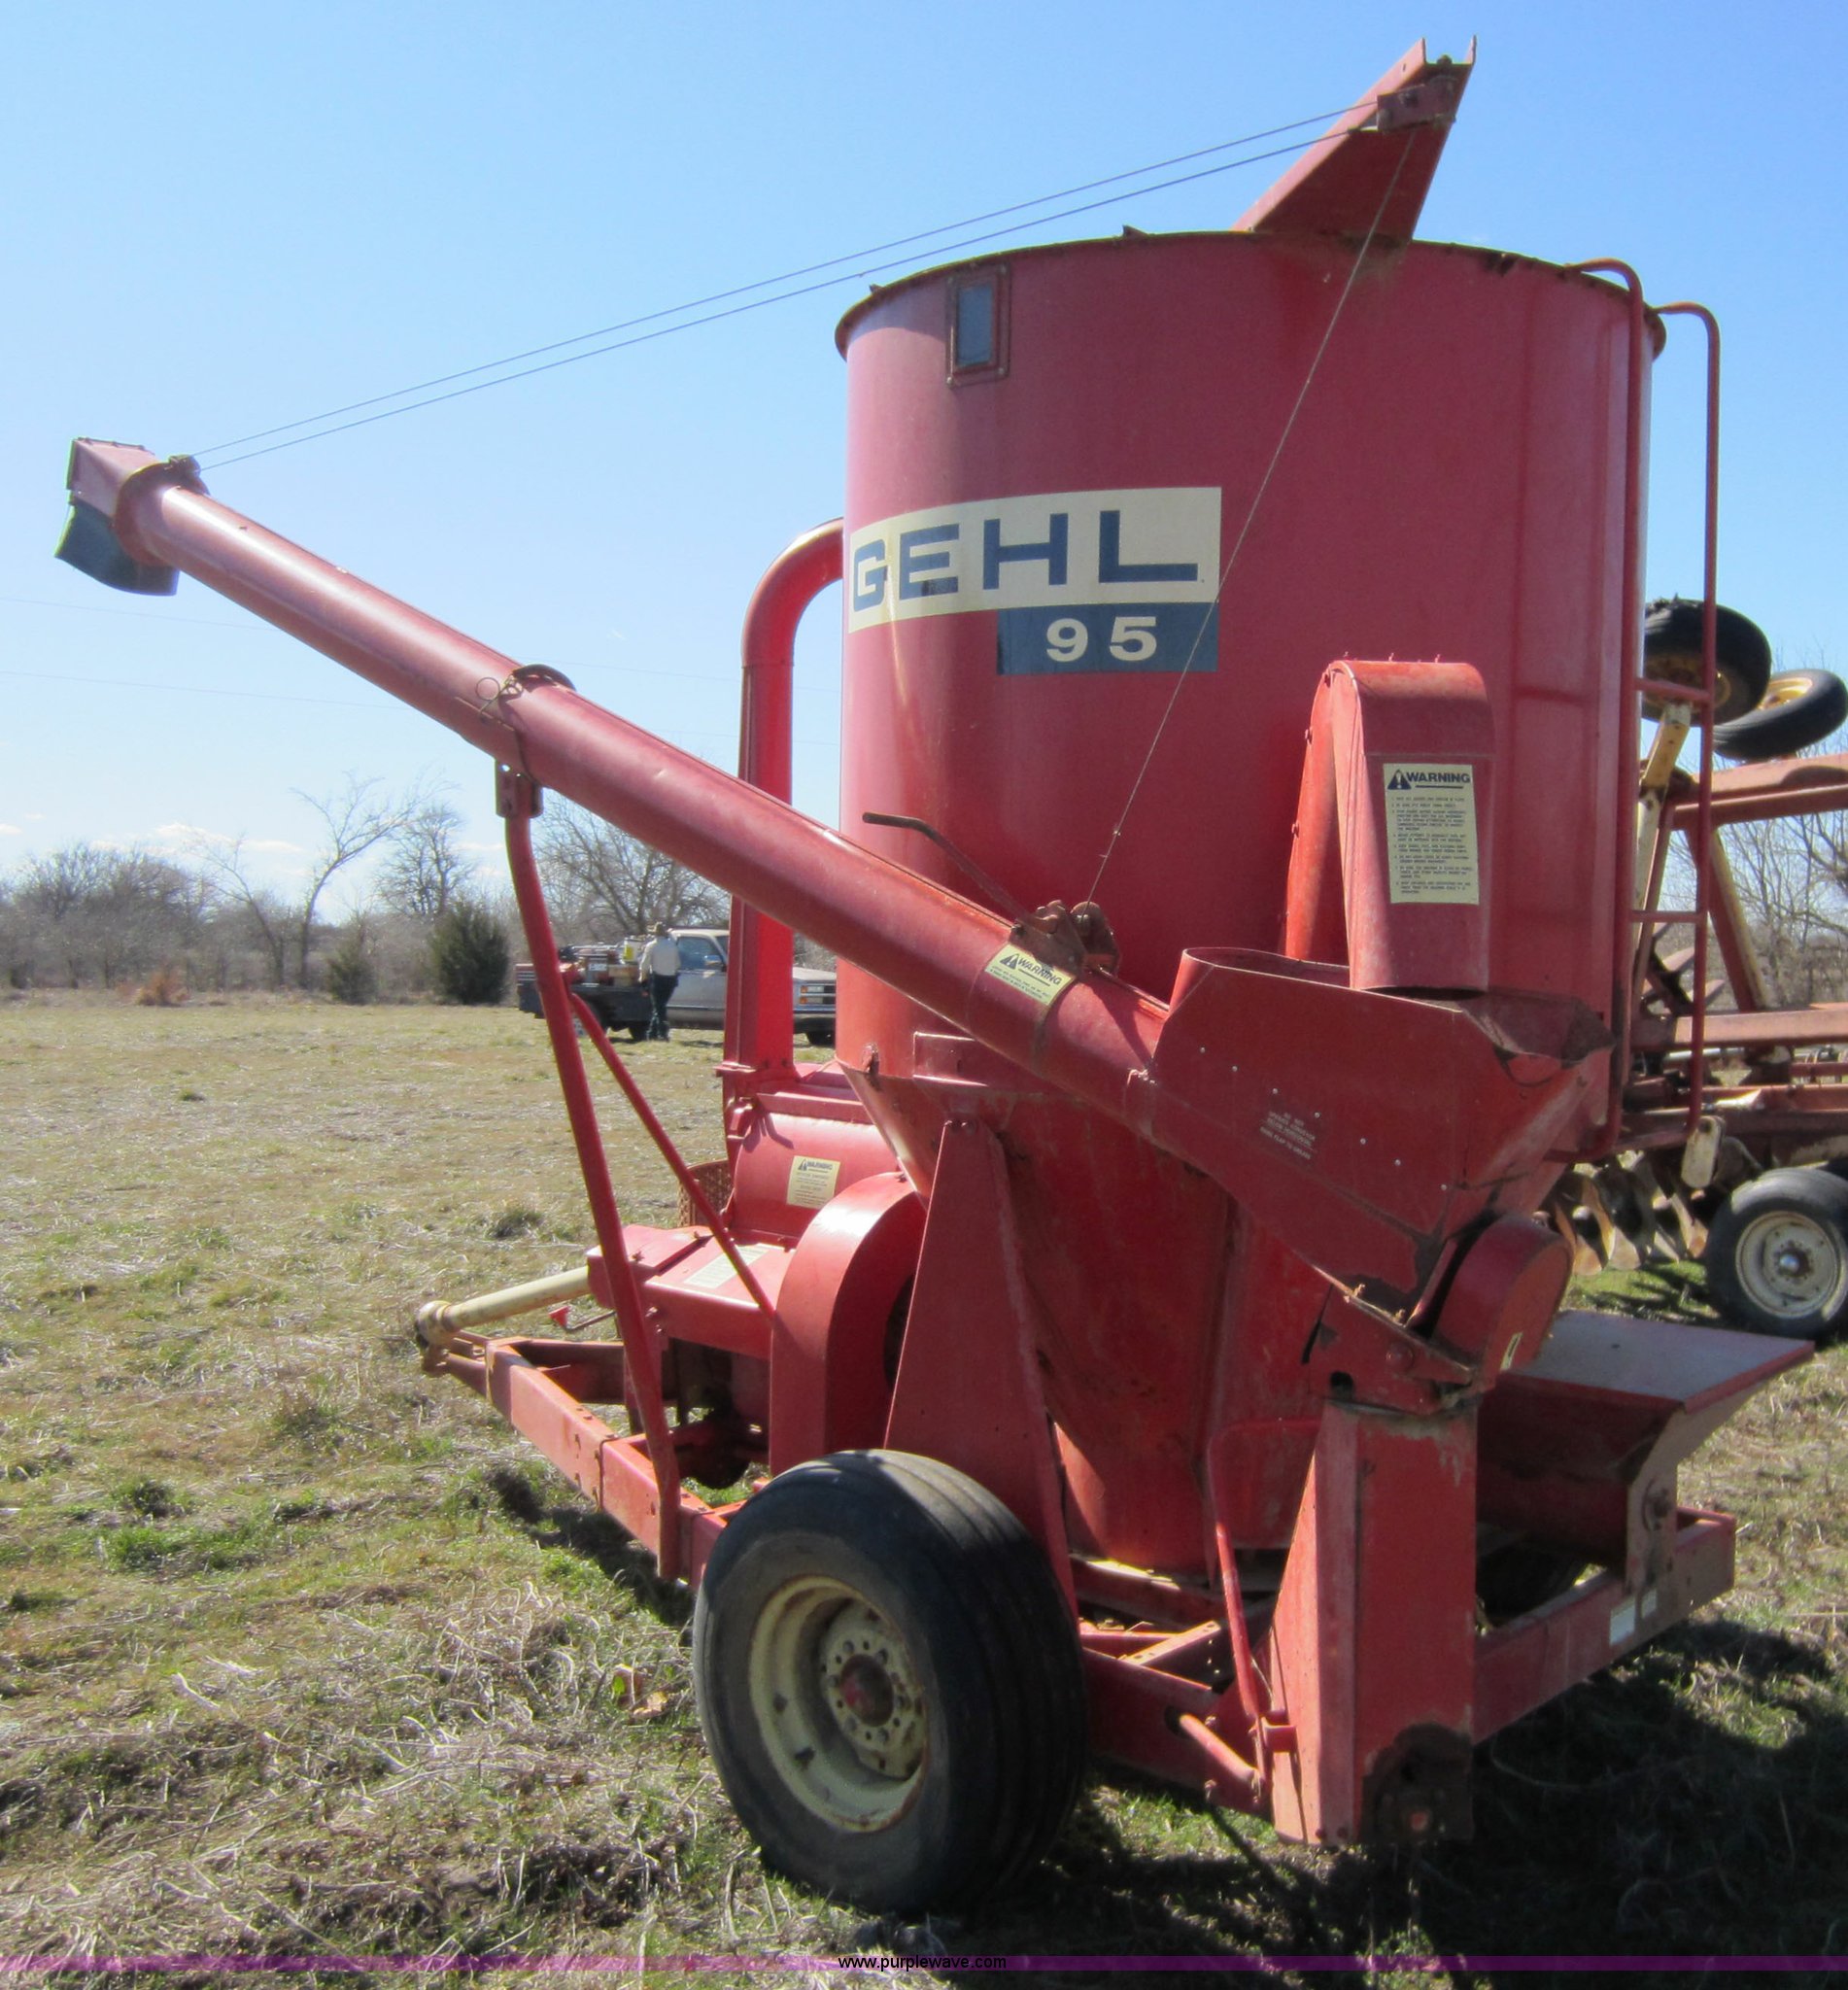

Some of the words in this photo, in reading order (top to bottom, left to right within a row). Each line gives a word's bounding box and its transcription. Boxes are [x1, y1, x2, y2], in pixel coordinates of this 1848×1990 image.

[853, 510, 1198, 612] GEHL
[1046, 616, 1157, 663] 95
[1406, 772, 1471, 784] WARNING
[1017, 957, 1063, 985] WARNING
